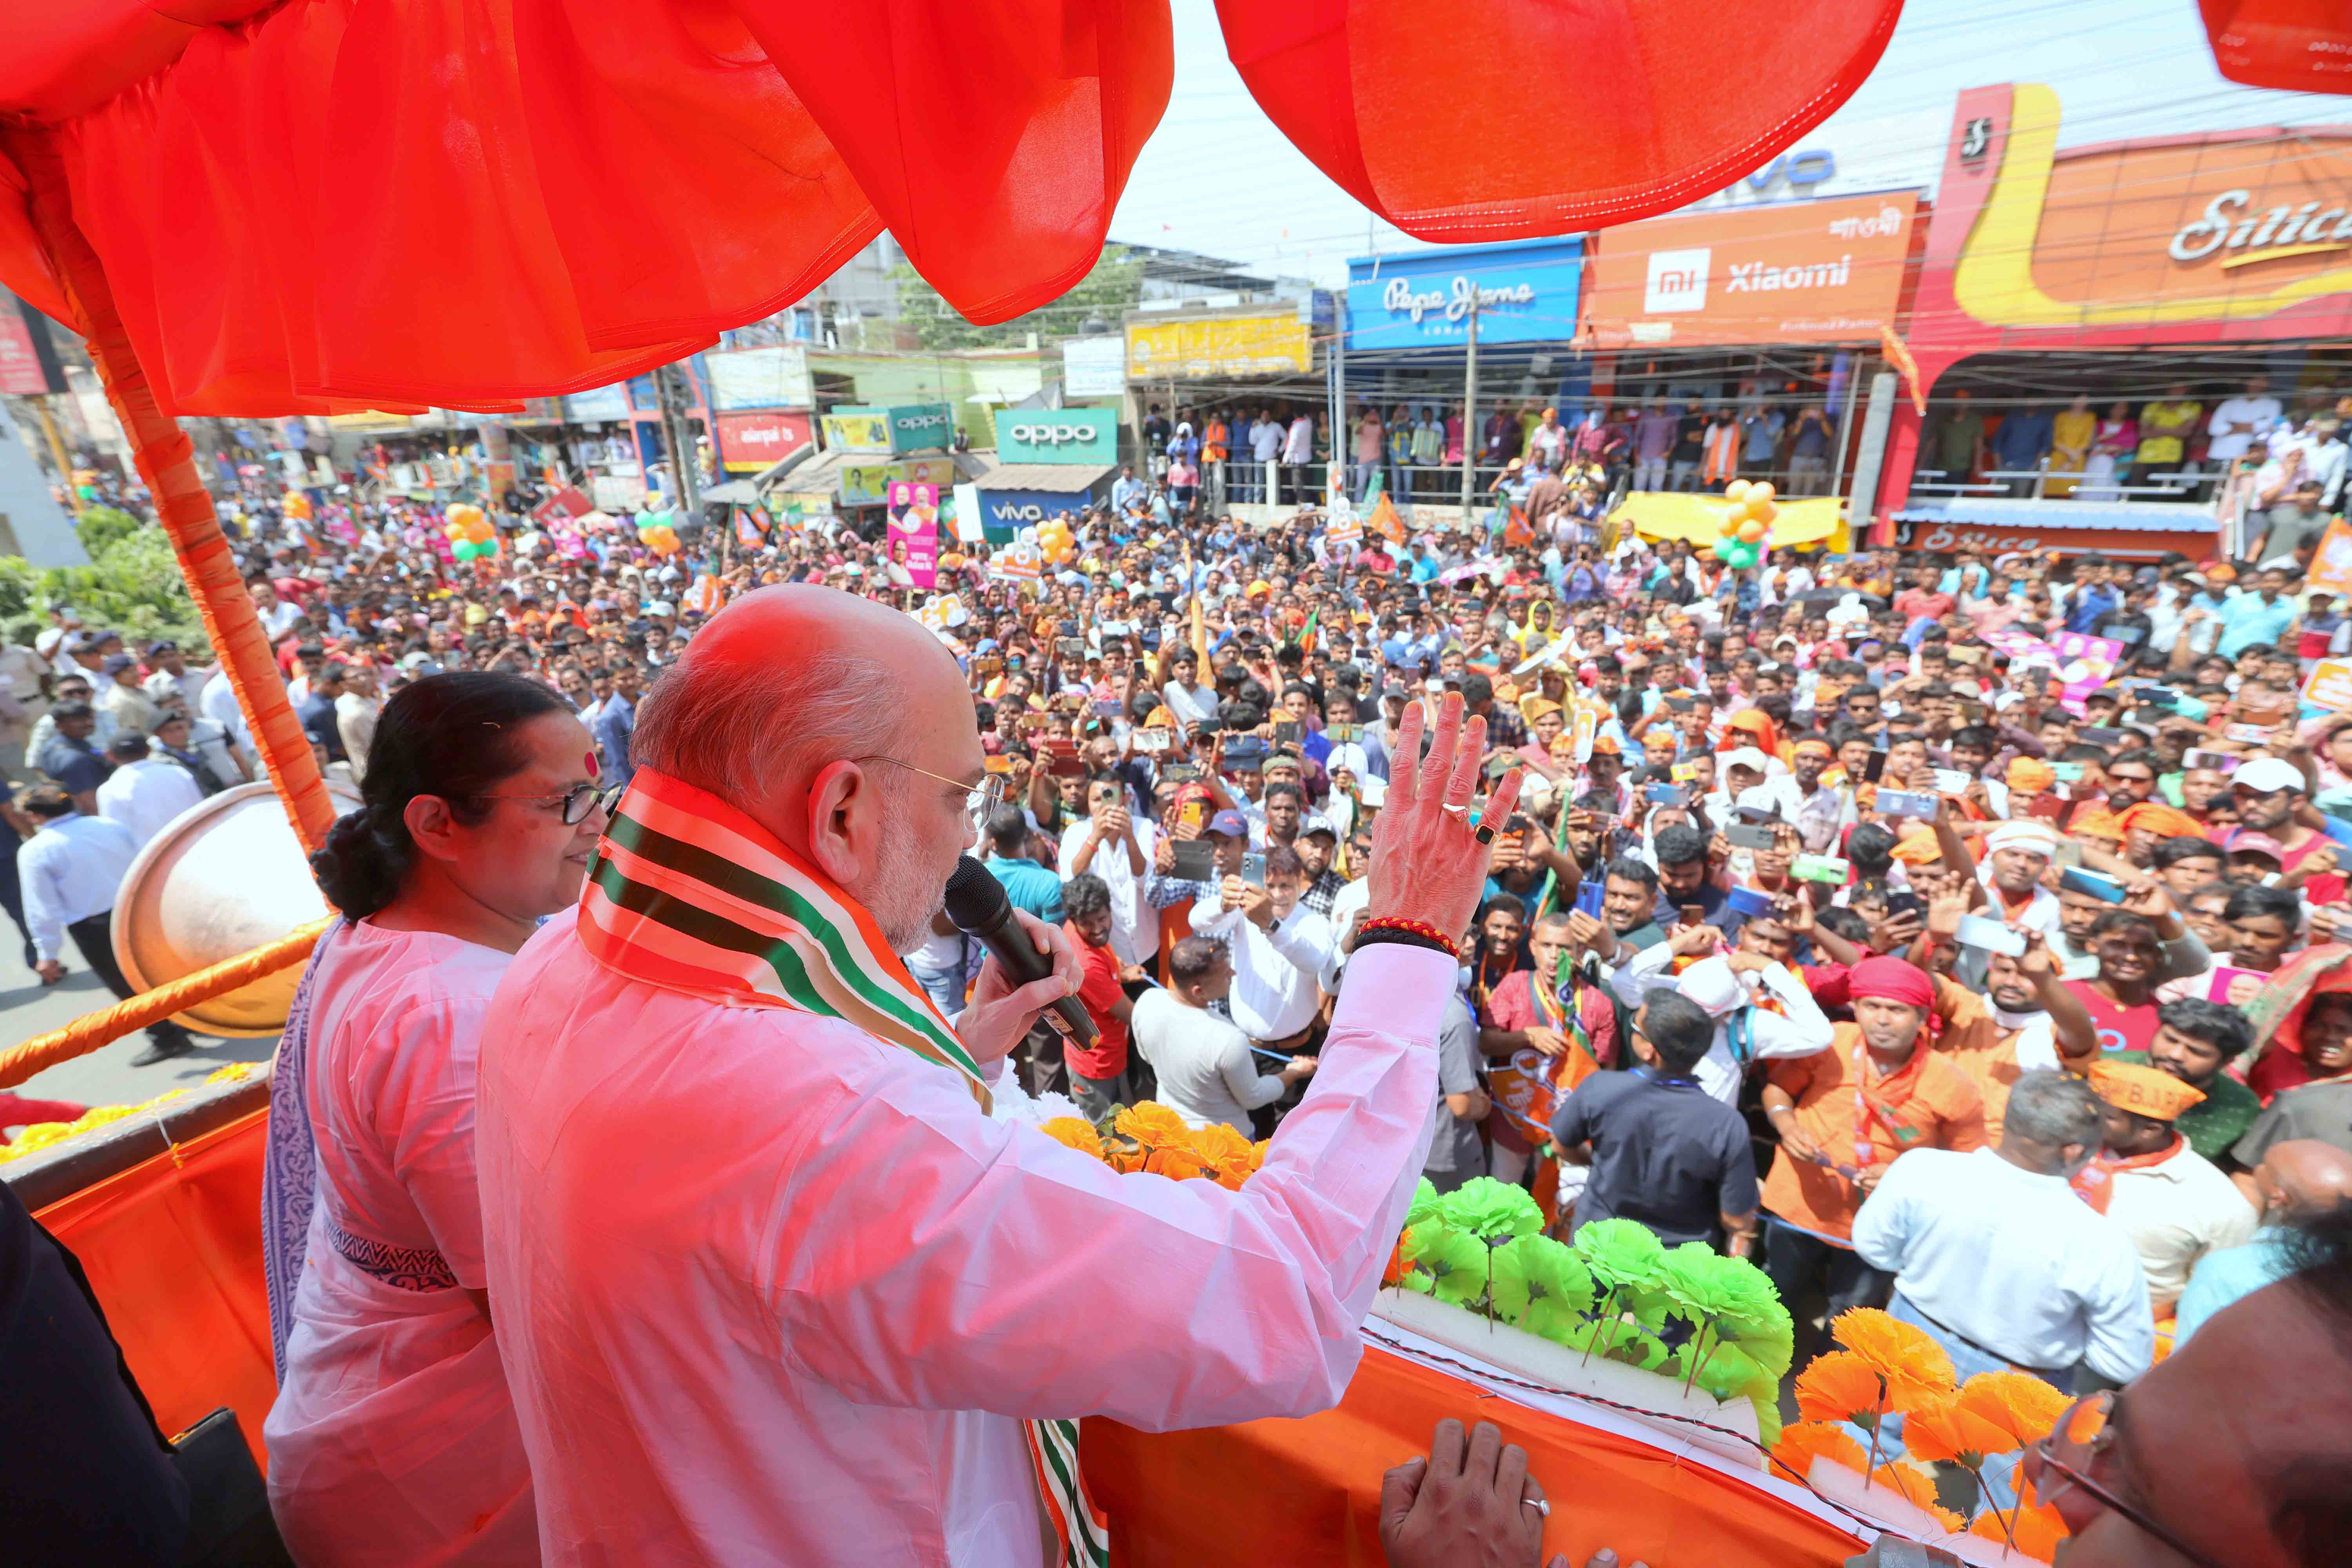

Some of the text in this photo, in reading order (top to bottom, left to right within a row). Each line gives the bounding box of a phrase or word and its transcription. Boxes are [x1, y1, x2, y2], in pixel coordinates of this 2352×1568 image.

[1726, 254, 1852, 293] Xiaomi
[1384, 277, 1446, 323] Pepe
[898, 414, 948, 430] oppo
[1010, 424, 1097, 445] oppo
[991, 501, 1042, 521] vivo
